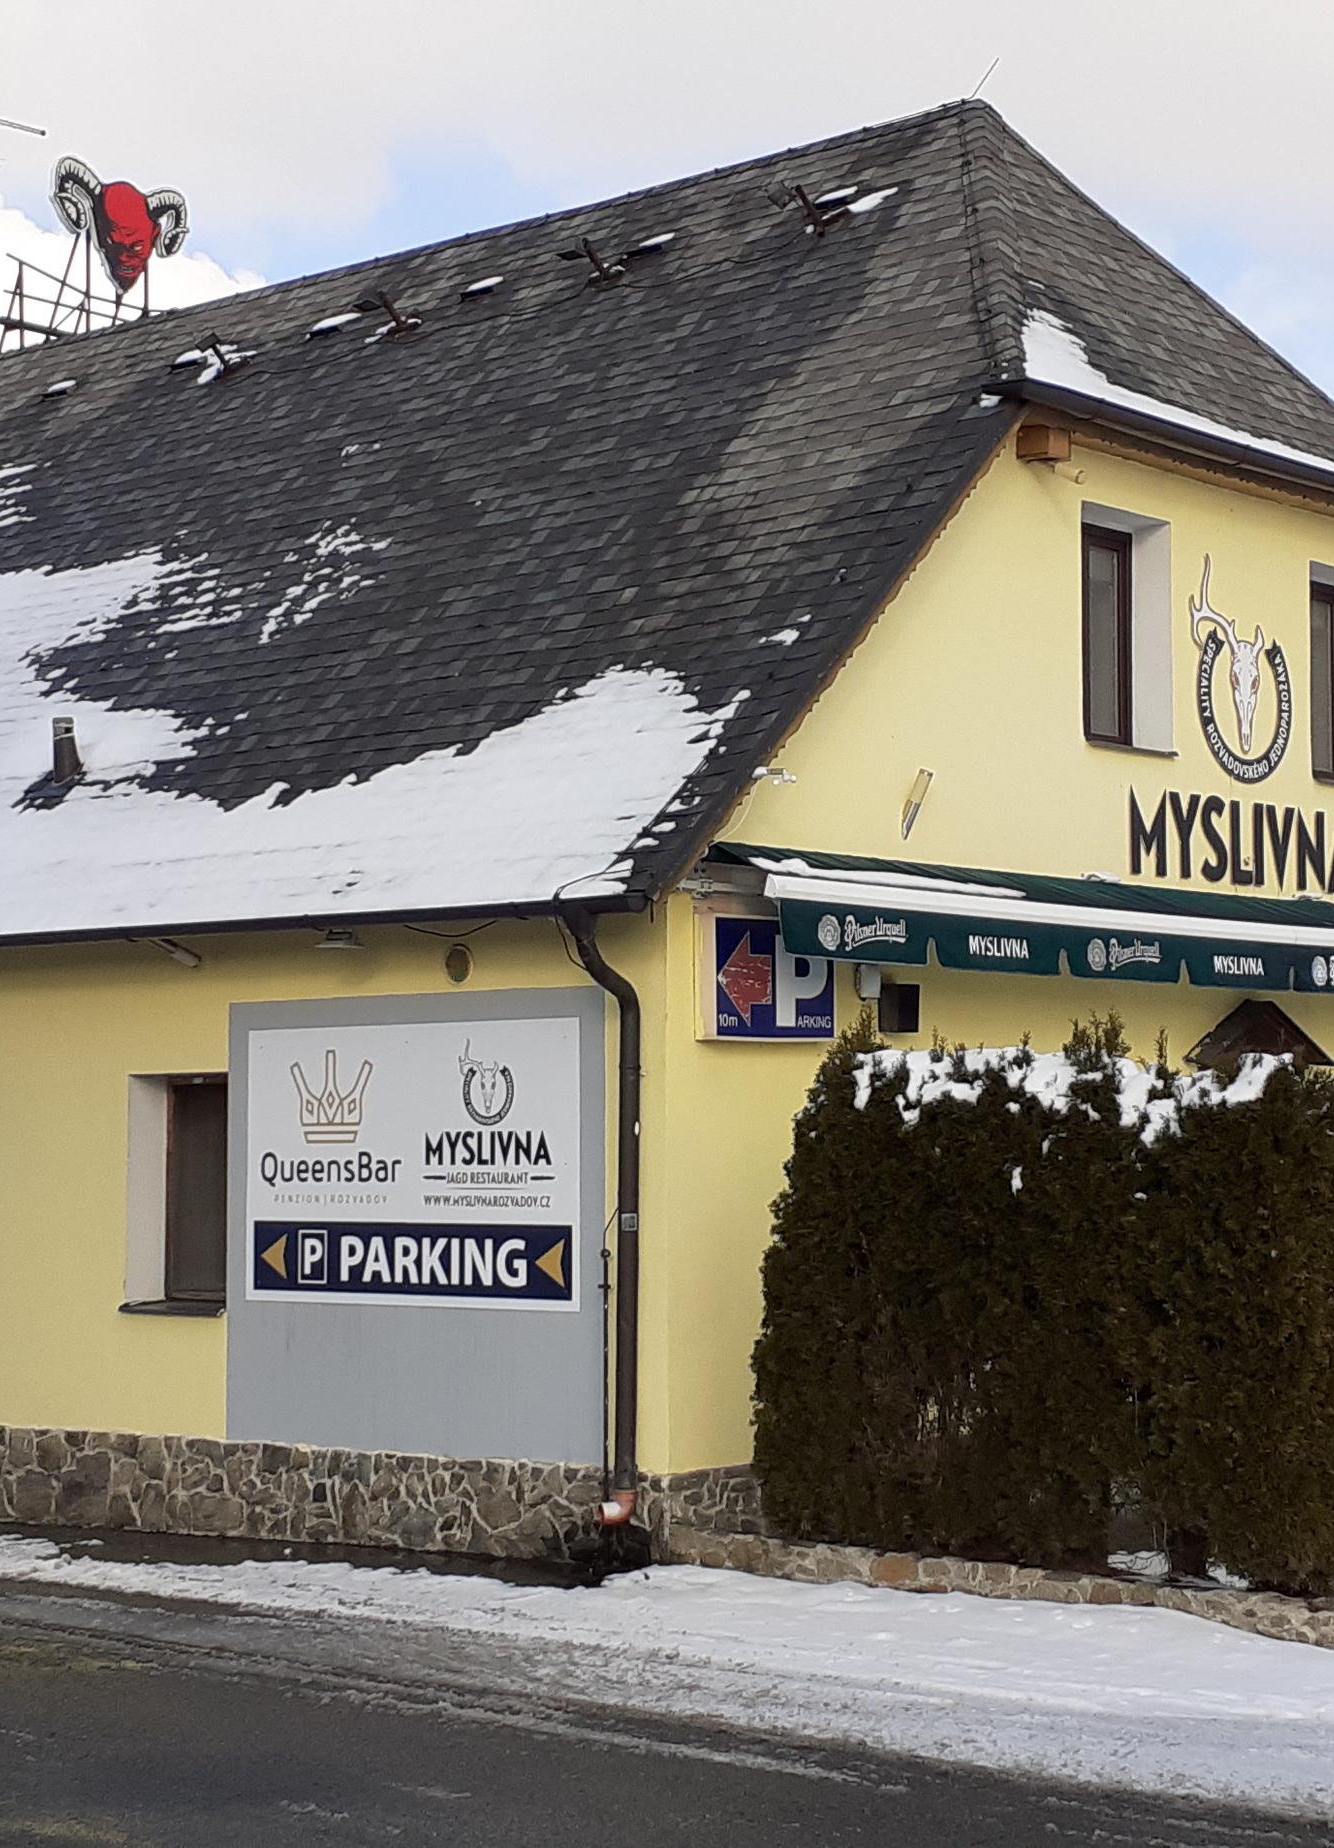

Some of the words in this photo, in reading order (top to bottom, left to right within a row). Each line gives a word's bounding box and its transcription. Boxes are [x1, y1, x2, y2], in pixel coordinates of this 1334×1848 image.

[1200, 638, 1217, 718] SPECIALITY
[844, 914, 876, 951] Pilsner
[875, 915, 907, 937] Urquell
[969, 934, 1029, 960] MYSLIVNA
[1213, 955, 1265, 976] MYSLIVNA
[424, 1131, 552, 1166] MYSLIVNA
[260, 1151, 402, 1188] QueensBar
[446, 1171, 468, 1185] JAGD
[470, 1171, 529, 1185] RESTAURANT
[423, 1194, 551, 1208] WWW.MYSLIVNAROZVADOV.CZ
[303, 1238, 322, 1275] P
[339, 1236, 528, 1288] PARKING
